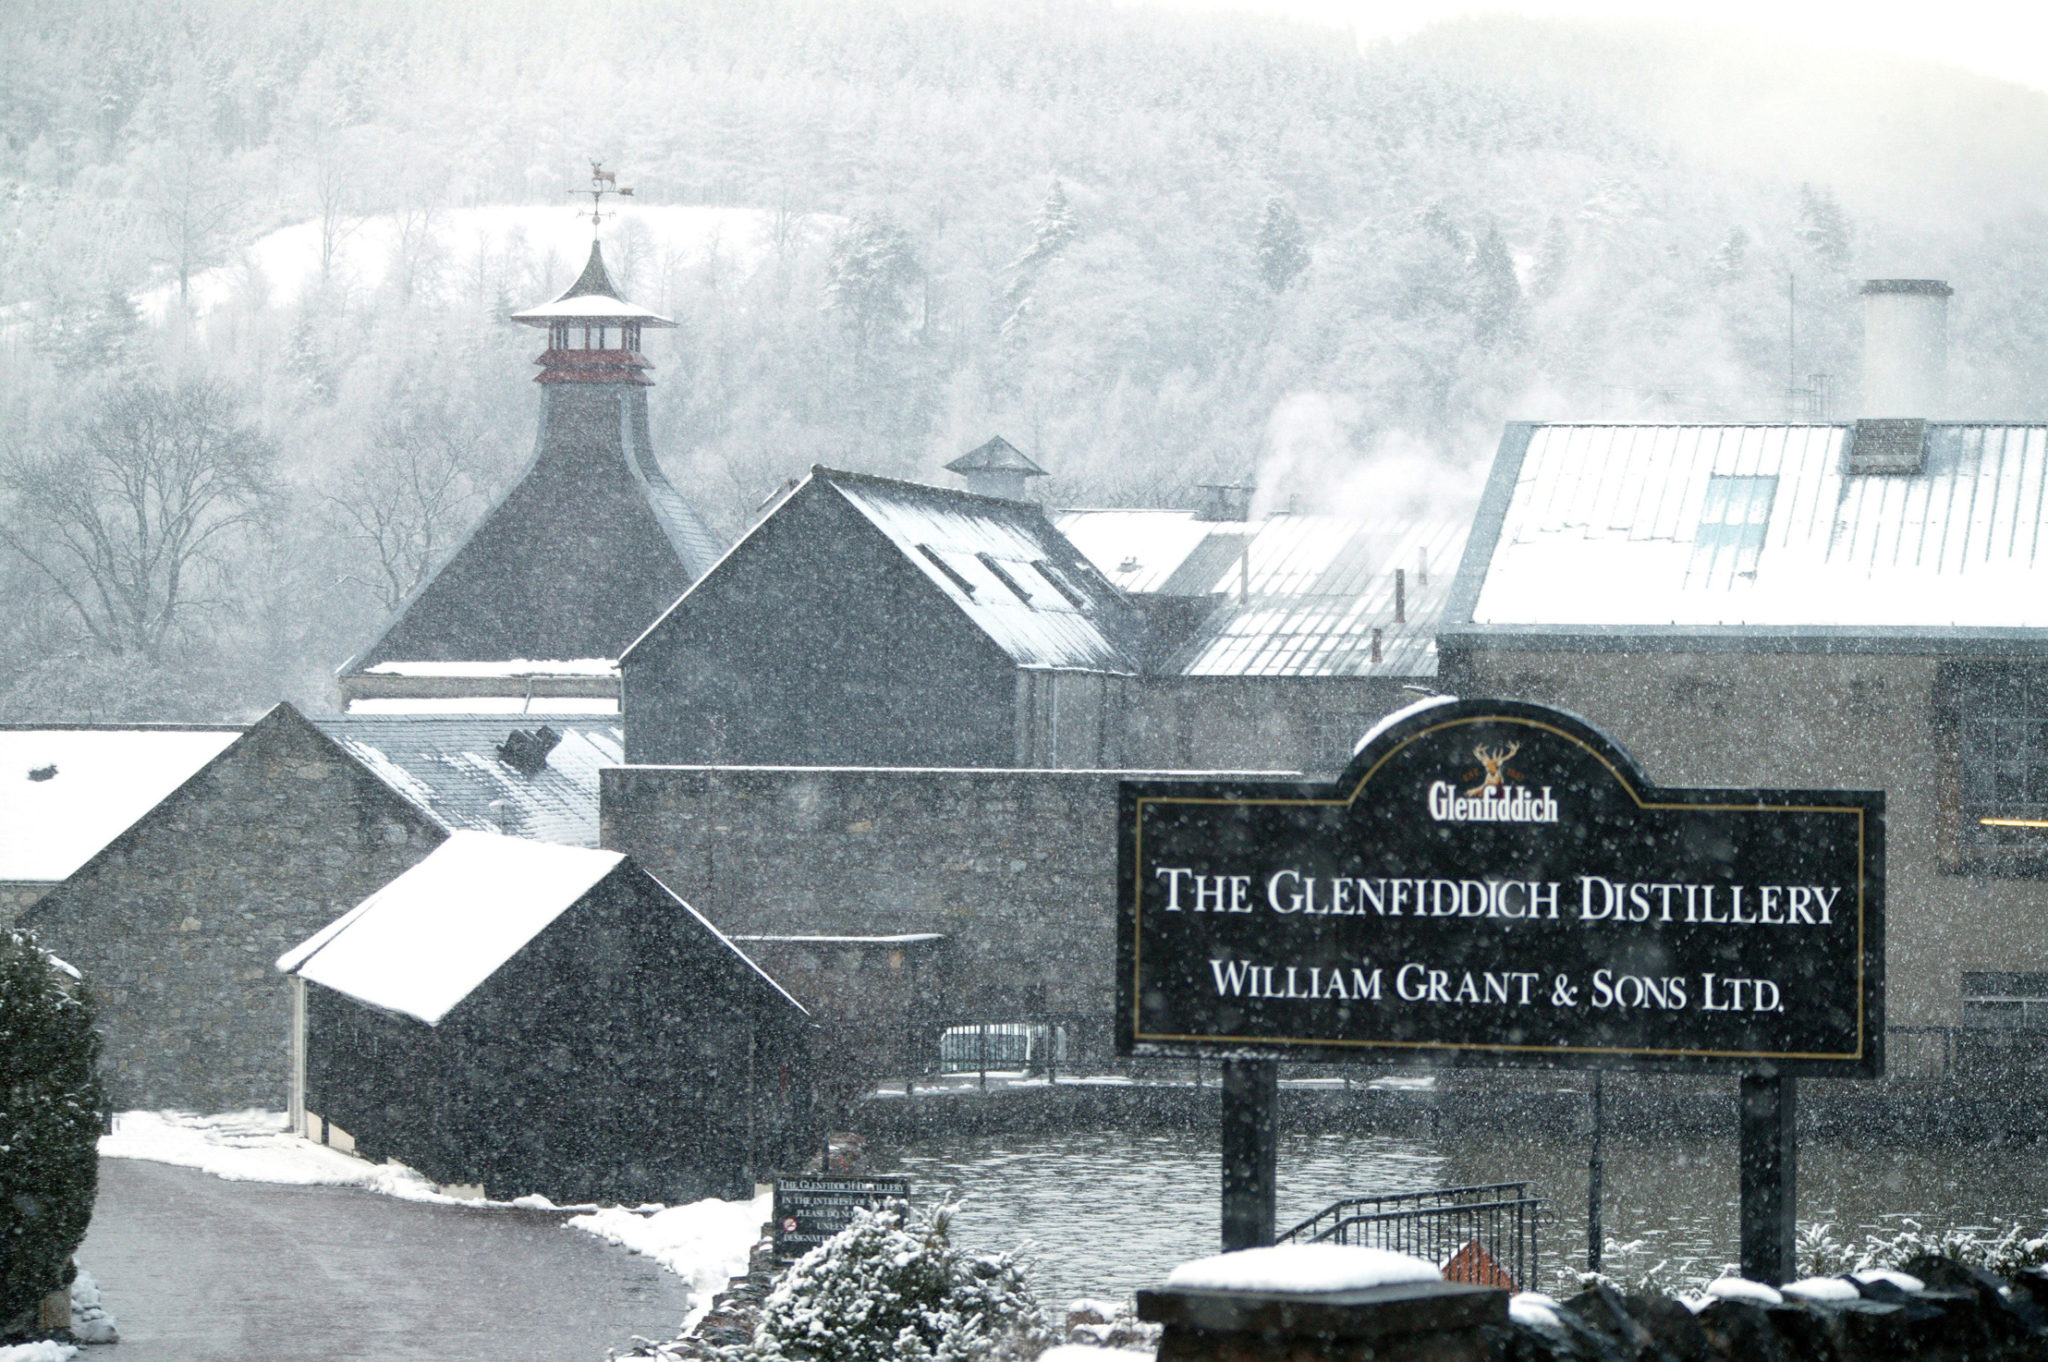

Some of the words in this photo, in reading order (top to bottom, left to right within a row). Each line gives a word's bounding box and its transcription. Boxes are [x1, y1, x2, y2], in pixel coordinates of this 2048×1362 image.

[1429, 780, 1559, 822] Glenfiddich
[1155, 867, 1253, 914] THE
[1267, 869, 1561, 919] GLENFIDDICH
[1580, 875, 1842, 925] DISTILLERY
[1209, 959, 1383, 1000] WILLIAM
[1396, 963, 1539, 1005] GRANT
[1551, 973, 1578, 1007] &
[1591, 968, 1687, 1010] SONS
[780, 1179, 798, 1189] THE
[781, 1196, 792, 1204] IN
[793, 1197, 810, 1205] THE
